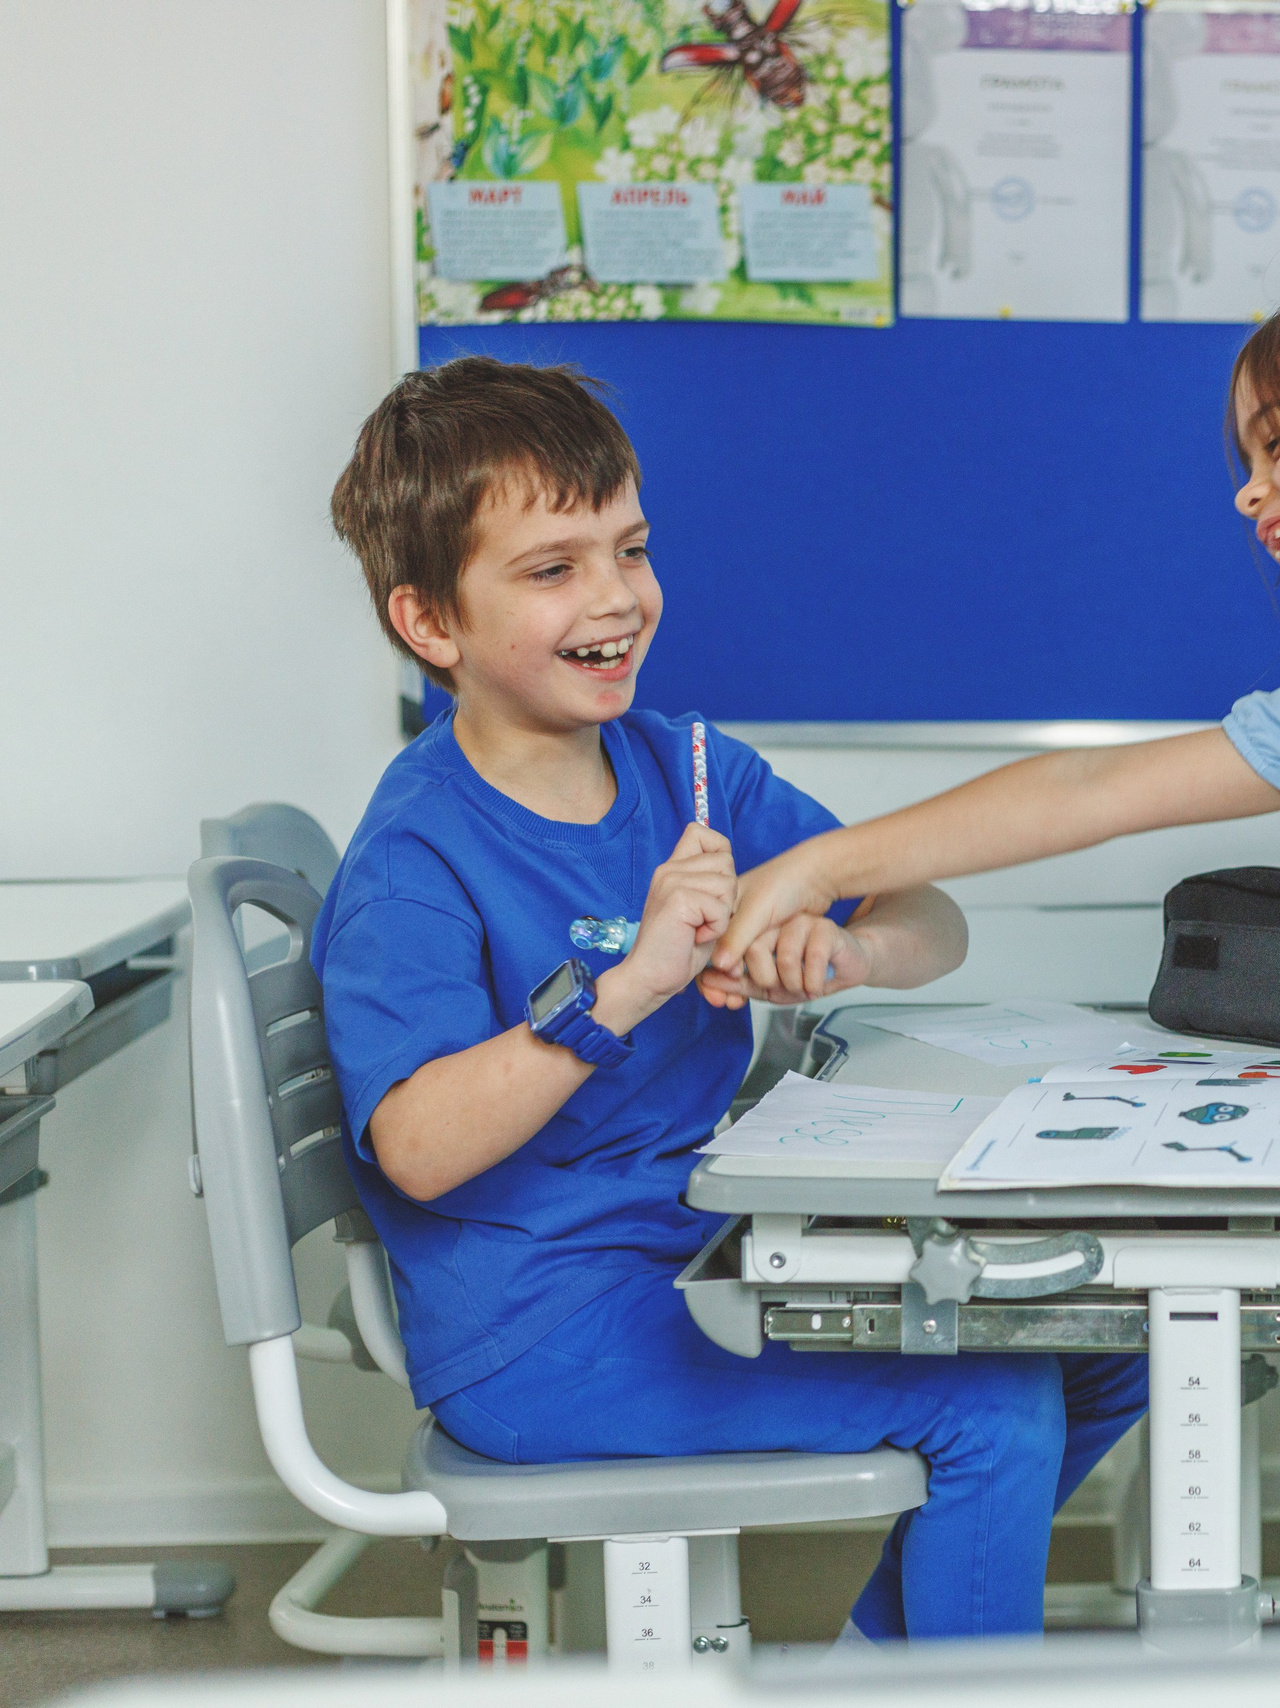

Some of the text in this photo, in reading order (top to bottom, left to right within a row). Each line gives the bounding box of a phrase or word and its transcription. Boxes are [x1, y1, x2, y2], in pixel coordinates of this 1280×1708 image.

[468, 186, 523, 204] МАРТ
[611, 186, 692, 205] АПРЕЛЬ
[780, 186, 827, 206] МАЙ
[779, 1093, 965, 1145] These
[1188, 1377, 1201, 1387] 54
[1188, 1413, 1201, 1423] 56
[1188, 1450, 1201, 1460] 58
[1188, 1486, 1201, 1496] 60
[1188, 1522, 1201, 1532] 62
[638, 1561, 651, 1571] 32
[1188, 1558, 1201, 1568] 64
[640, 1595, 652, 1605] 34
[641, 1628, 654, 1638] 36
[642, 1661, 655, 1670] 38
